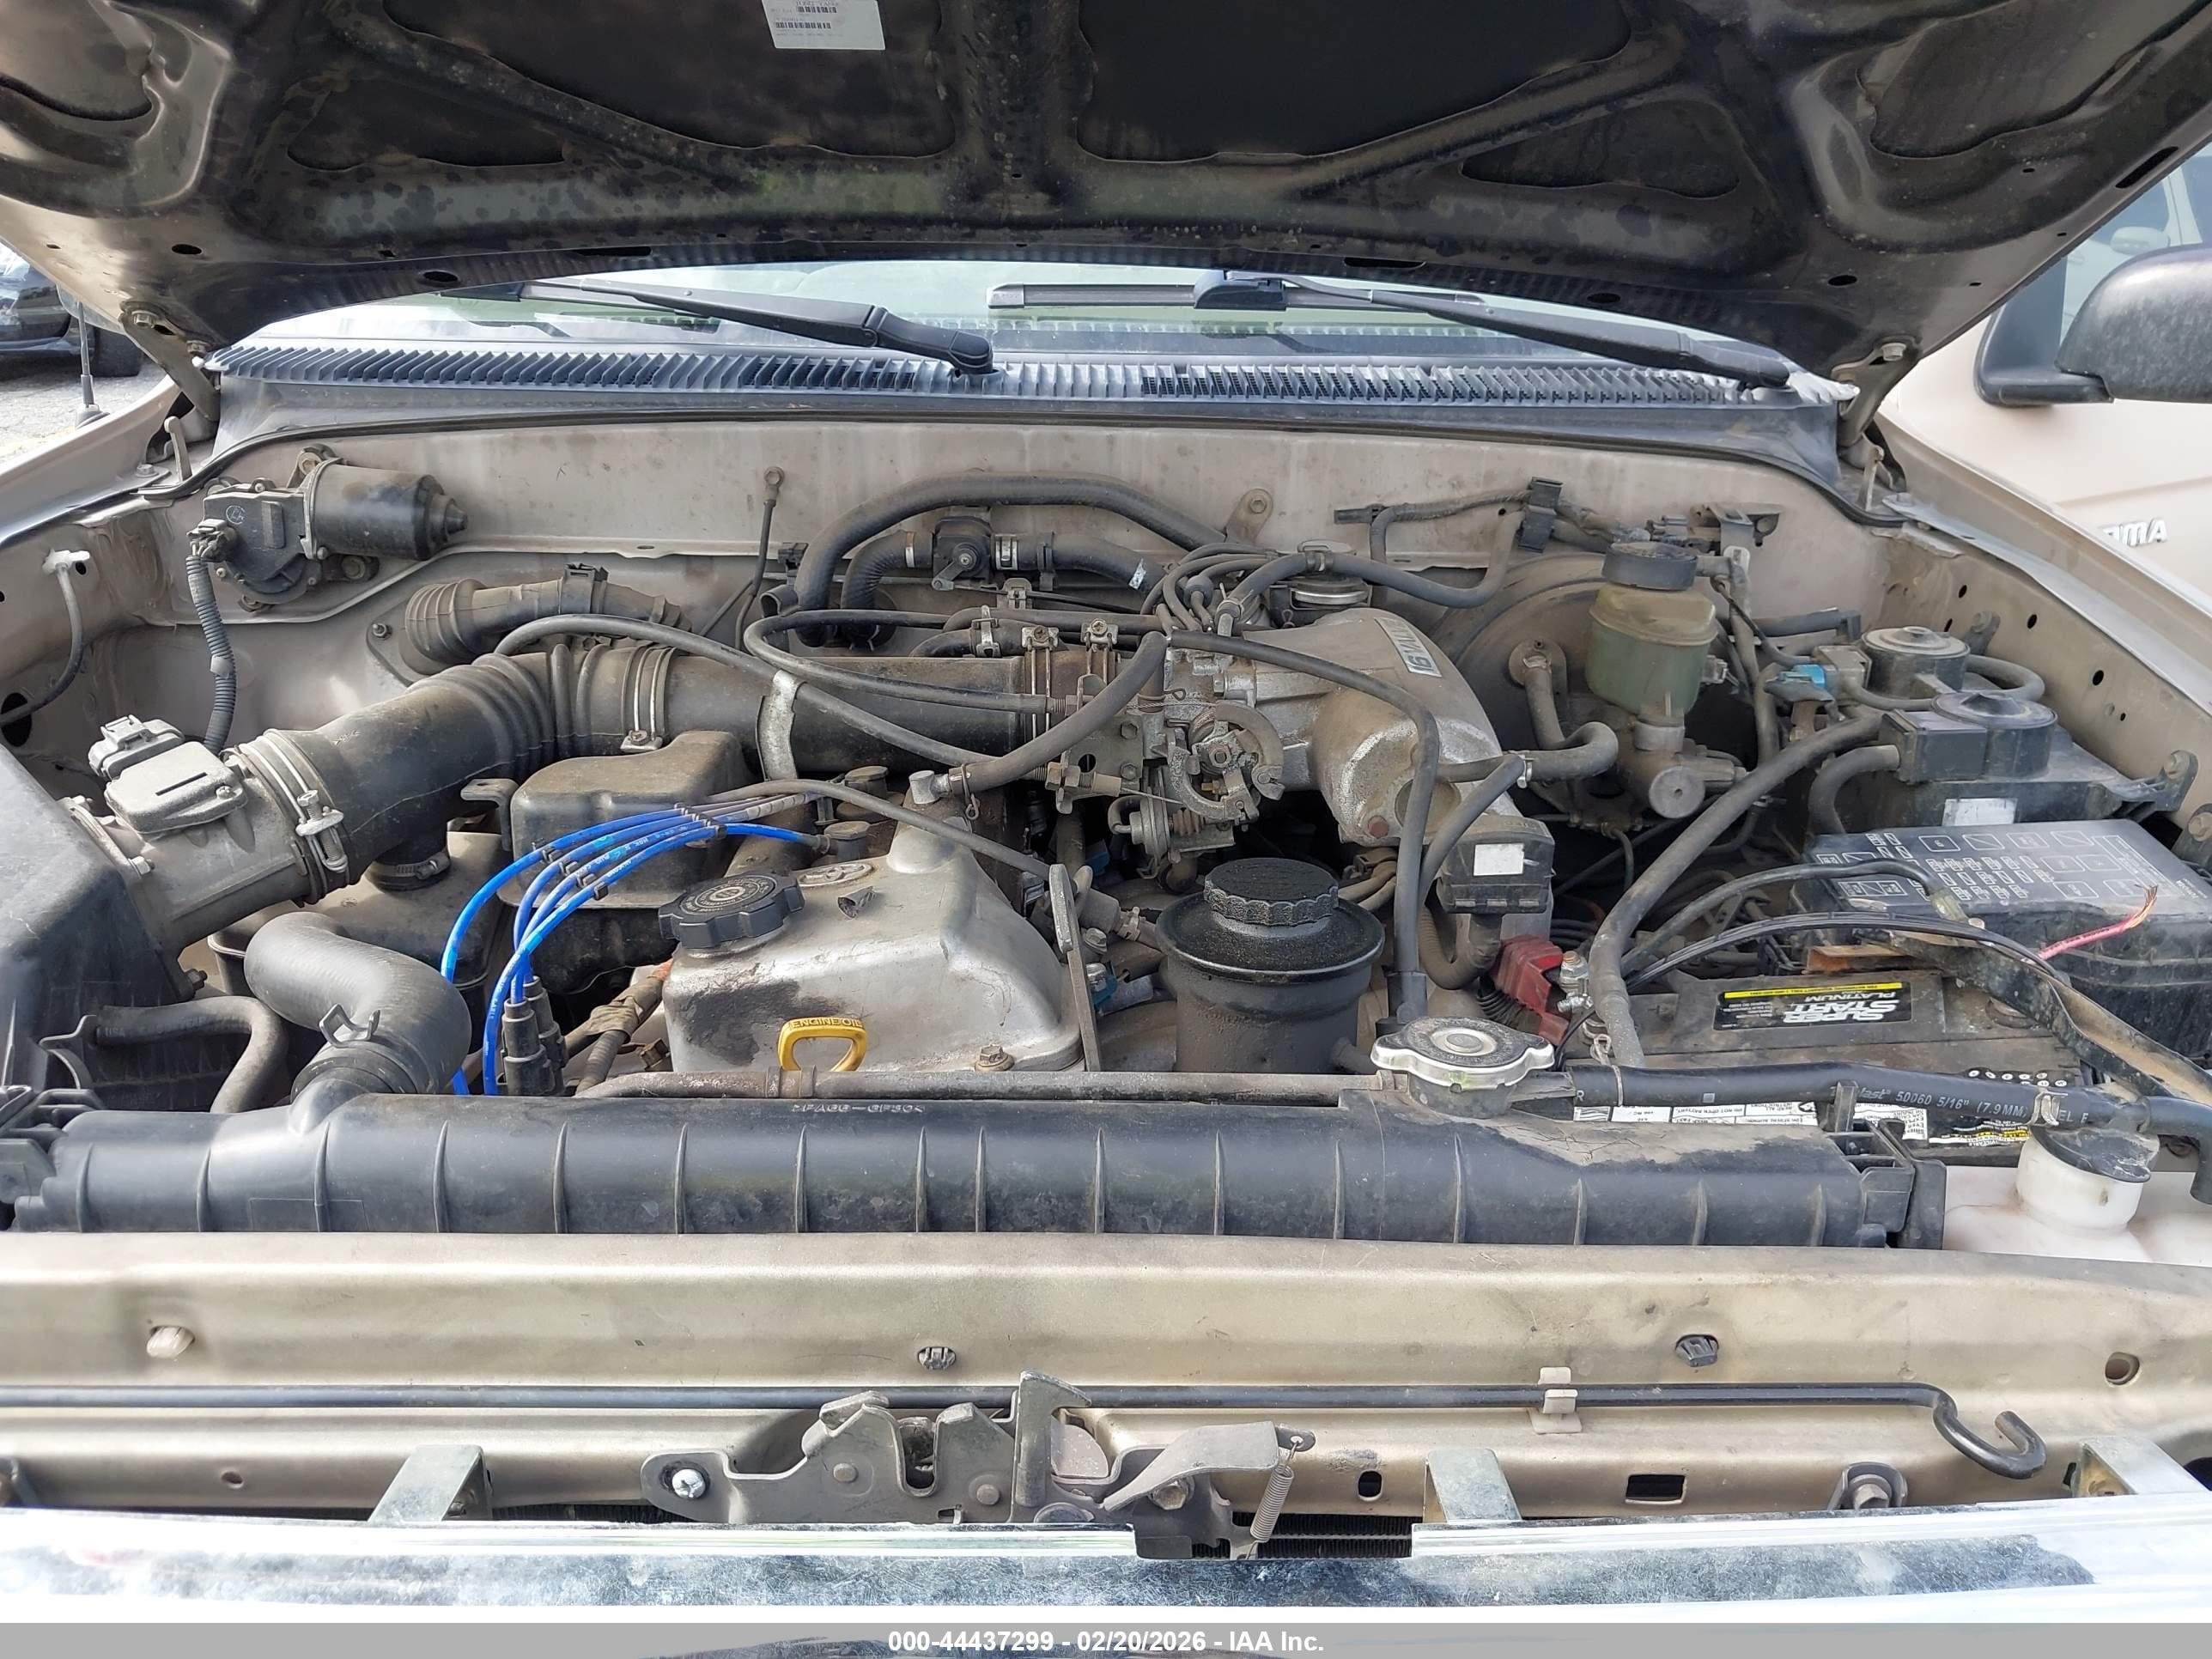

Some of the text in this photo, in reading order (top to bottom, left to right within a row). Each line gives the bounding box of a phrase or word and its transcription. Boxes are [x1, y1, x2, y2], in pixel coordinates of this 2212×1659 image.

[1804, 991, 1897, 1003] PLATINUM
[1794, 1000, 1900, 1013] START
[1783, 1010, 1885, 1024] SUPER
[791, 1018, 863, 1030] ENGINE OIL
